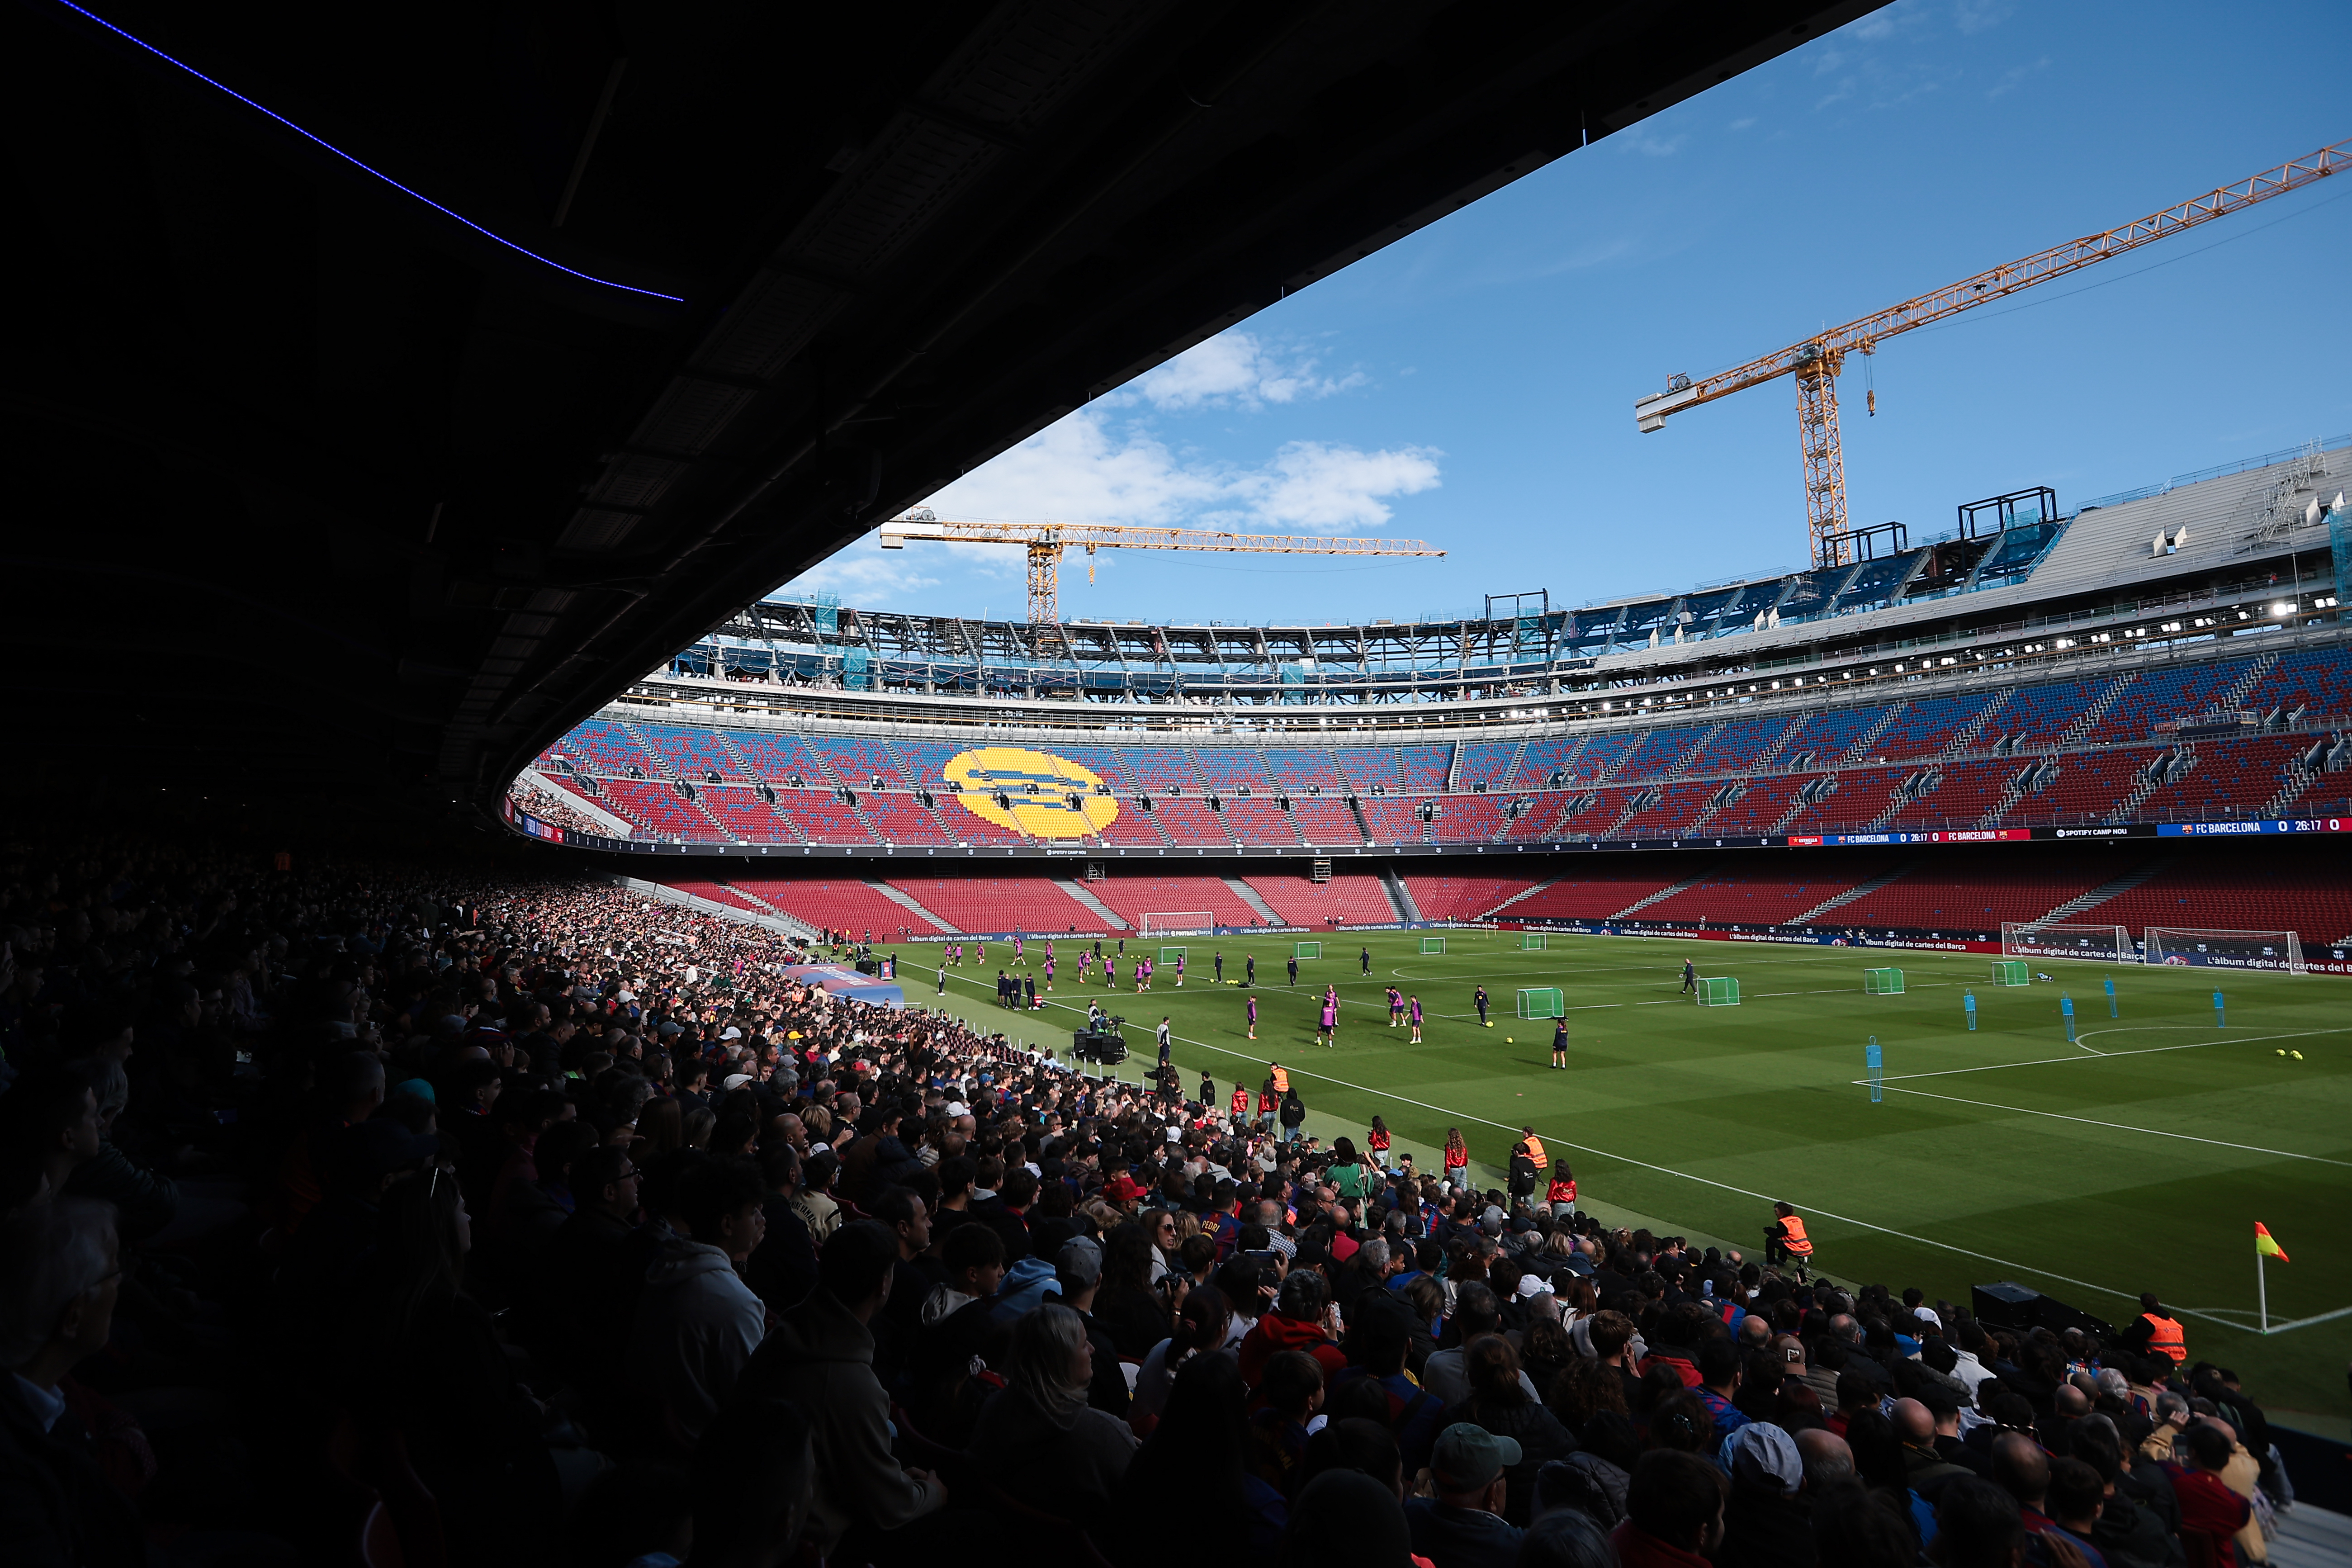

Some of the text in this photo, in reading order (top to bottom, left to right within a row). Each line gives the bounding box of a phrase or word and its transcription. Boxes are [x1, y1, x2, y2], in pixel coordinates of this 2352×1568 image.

[2196, 822, 2261, 834] FC BARCELONA
[2278, 821, 2287, 832] 0
[2295, 820, 2321, 831] 26:17
[2329, 819, 2339, 830] 0
[1855, 834, 1889, 843] BARCELONA
[1900, 834, 1907, 842] 0
[1911, 833, 1928, 841] 26:17
[1932, 833, 1939, 842] 0
[1948, 831, 1996, 841] FC BARCELONA
[2043, 947, 2067, 956] digital
[2207, 957, 2244, 966] L'àlbum
[2246, 958, 2277, 968] digital
[2294, 963, 2325, 971] cartes
[2328, 963, 2344, 971] del
[800, 1205, 816, 1224] YAMAL
[1202, 1220, 1221, 1233] PEDRI
[2066, 1363, 2089, 1374] PEDRI
